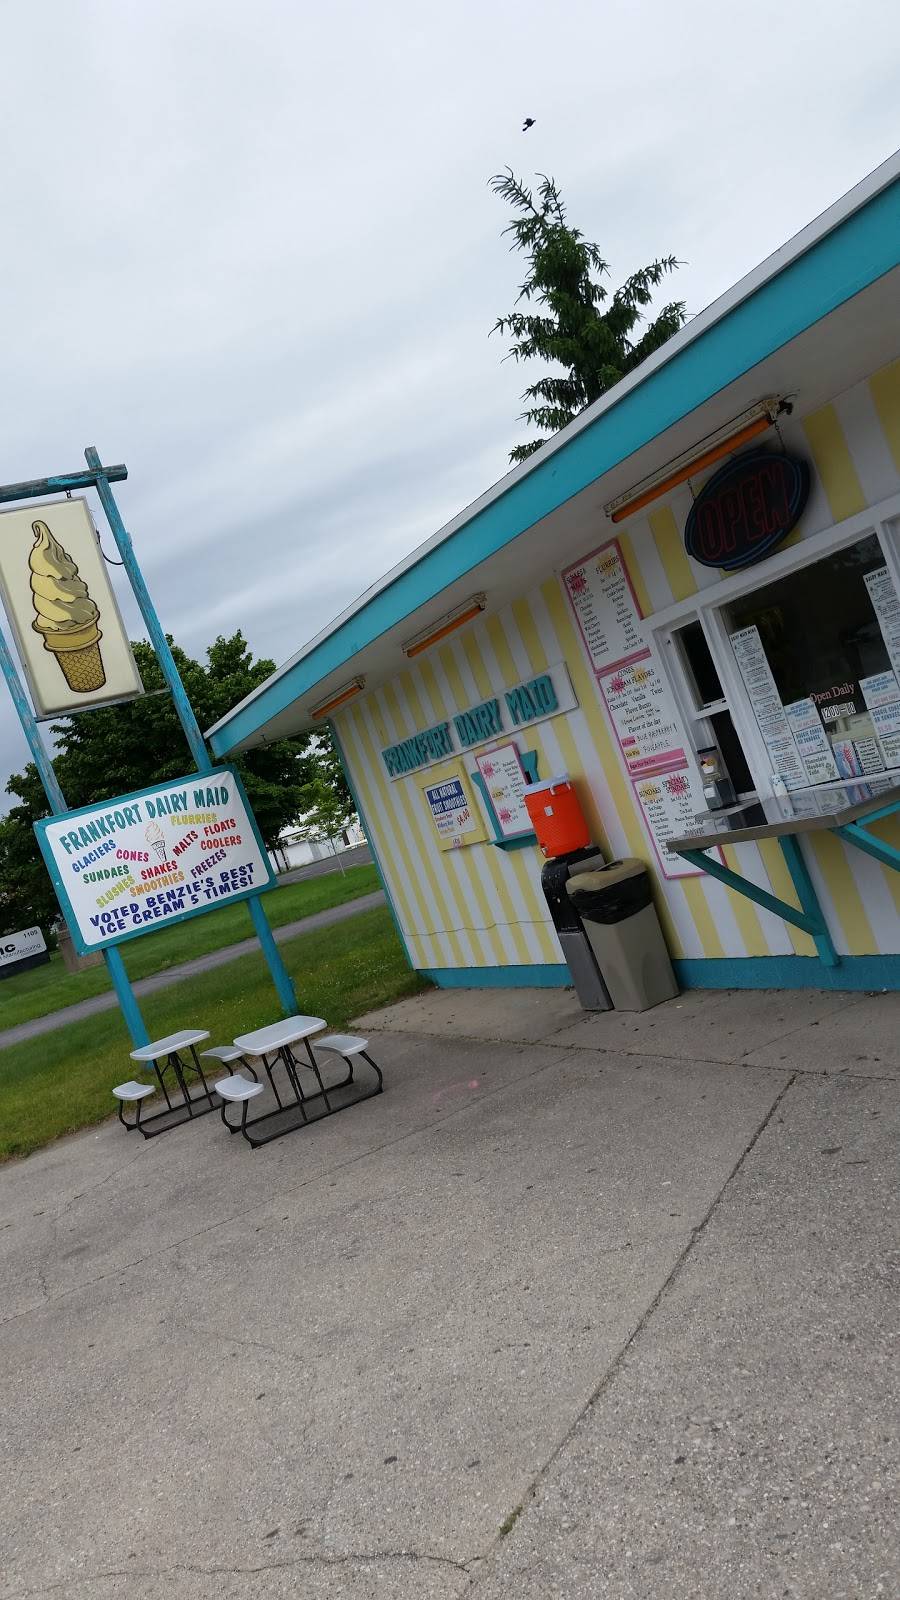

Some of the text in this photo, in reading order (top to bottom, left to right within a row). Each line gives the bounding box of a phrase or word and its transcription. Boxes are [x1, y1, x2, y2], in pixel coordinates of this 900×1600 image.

[697, 463, 789, 559] OPEN
[810, 690, 832, 704] Open
[832, 682, 854, 698] Daily
[381, 675, 559, 777] FRANKFORT DAIRY MAID
[59, 786, 229, 854] FRANKFORT DAIRY MAID
[170, 813, 217, 826] FLURRIES
[204, 819, 236, 836] FLOATS
[116, 849, 149, 862] CONES
[172, 830, 199, 856] MALTS
[200, 835, 242, 850] COOLERS
[72, 839, 117, 873] GLACIERS
[190, 849, 227, 878] FREEZES
[83, 864, 130, 883] SUNDAES
[140, 860, 178, 880] SHAKES
[90, 863, 255, 927] VOTED BENZIE'S BEST
[95, 875, 135, 908] SLUSHES
[129, 871, 185, 897] SMOOTHIES
[100, 875, 254, 936] ICE CREAM 5 TIMES!
